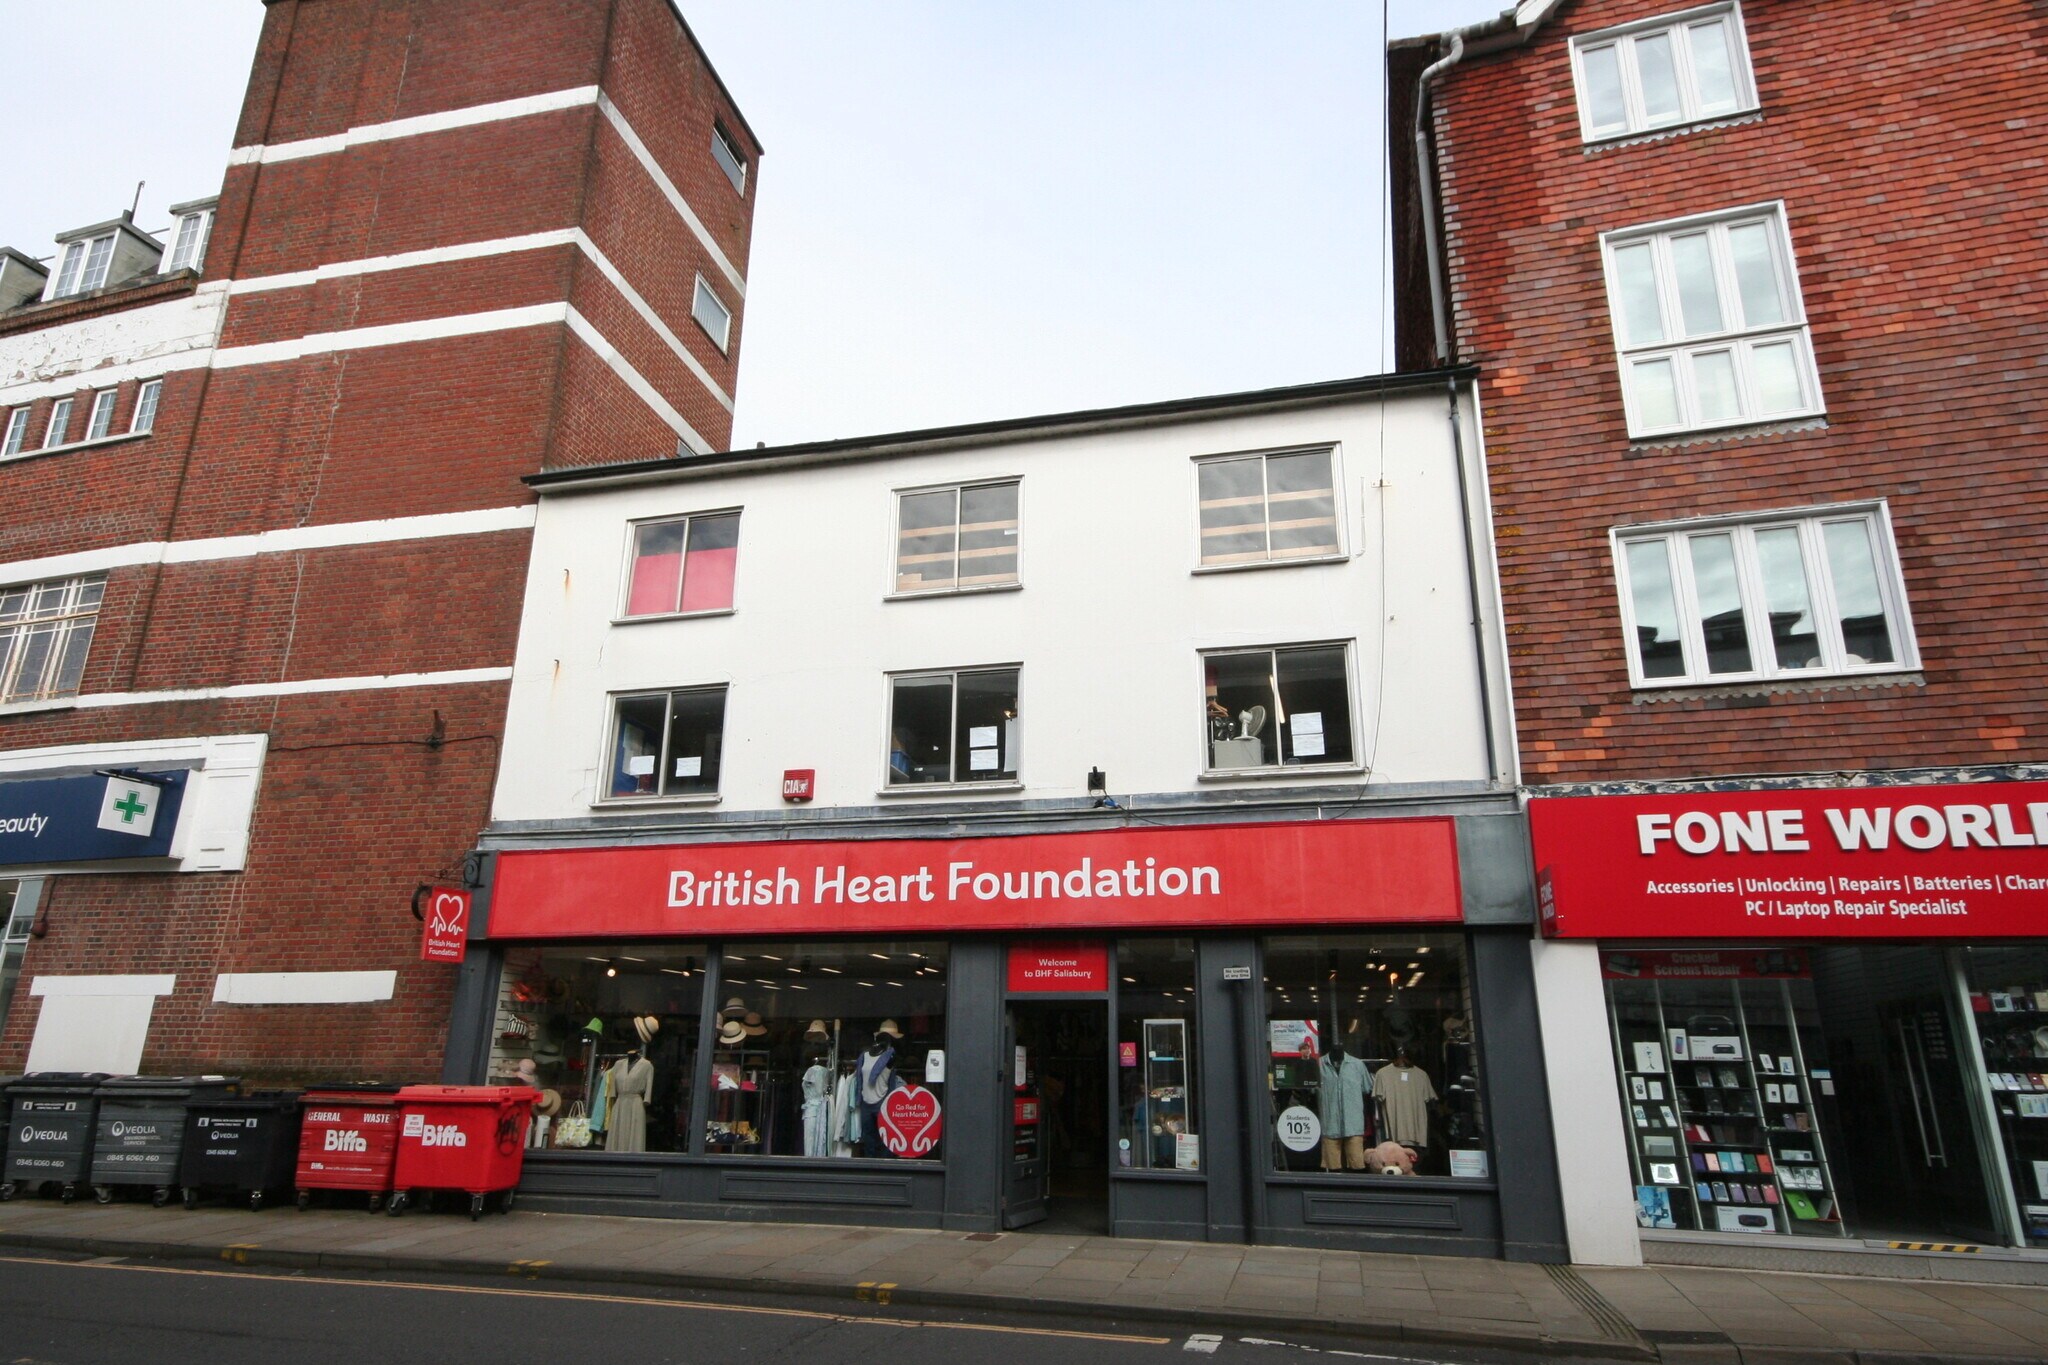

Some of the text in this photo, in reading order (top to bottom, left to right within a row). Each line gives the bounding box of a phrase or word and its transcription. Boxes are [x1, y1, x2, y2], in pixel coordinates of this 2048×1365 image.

[1637, 811, 1810, 854] FONE
[668, 857, 1221, 907] British Heart Foundation
[1647, 879, 1735, 894] Accessories
[1746, 877, 1827, 895] Unlocking
[1838, 876, 1901, 895] Repairs
[1913, 875, 1993, 891] Batteries
[2005, 874, 2048, 890] Char
[1746, 901, 1765, 916] PC
[1777, 900, 1830, 920] Laptop
[1834, 899, 1885, 919] Repair
[1889, 898, 1967, 919] Specialist
[428, 938, 446, 947] British
[428, 948, 458, 956] Foundation
[1038, 958, 1077, 967] Welcome
[1024, 969, 1092, 979] to BHF Salisbury
[308, 1112, 390, 1124] GENERAL WASTE
[34, 1130, 68, 1141] VEOLIA
[125, 1126, 156, 1134] VEOLIA
[422, 1125, 466, 1147] Biffa
[324, 1129, 367, 1152] Biffa
